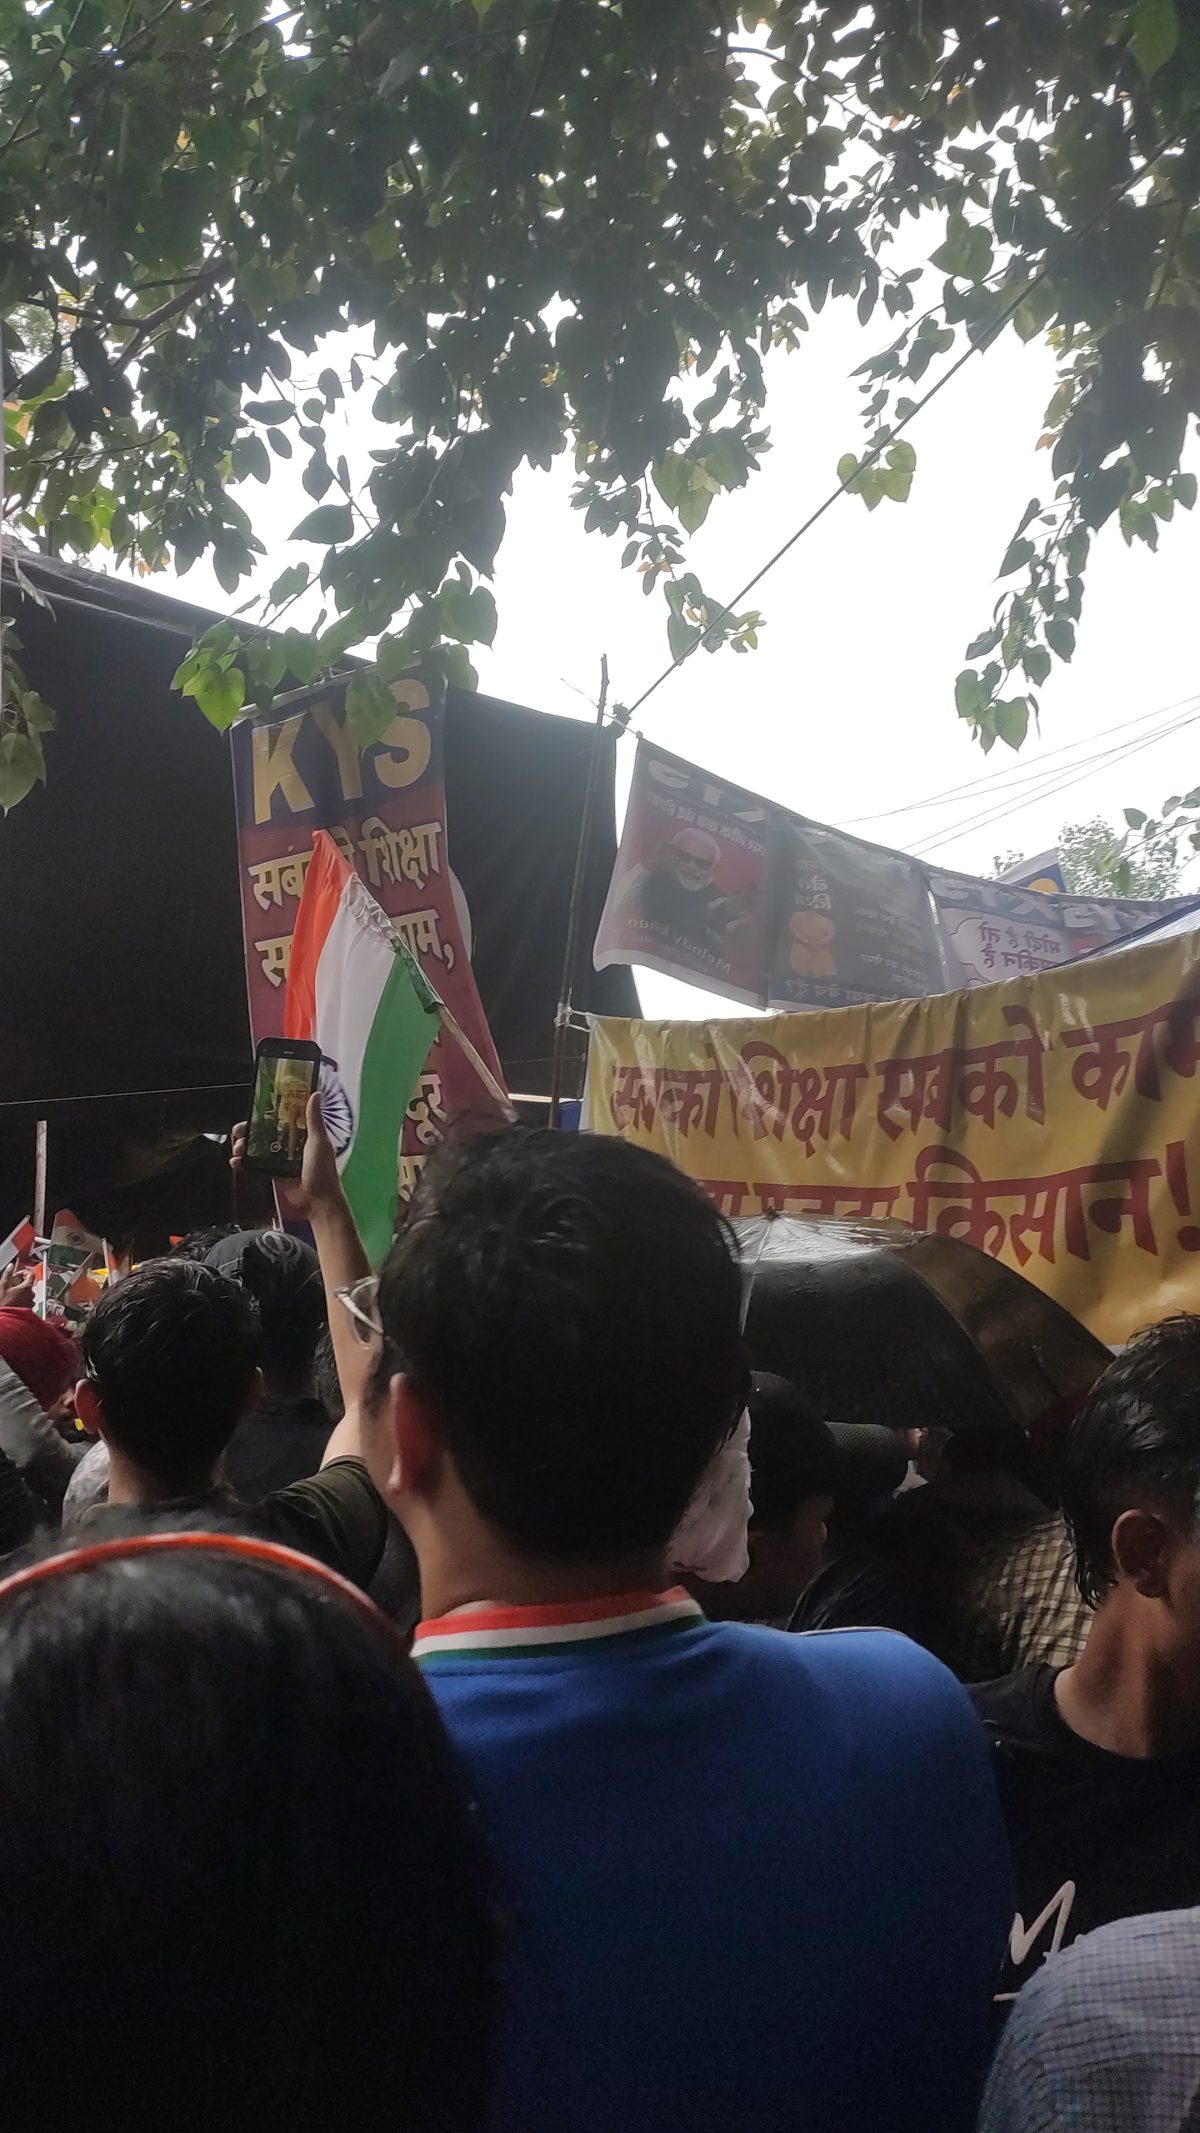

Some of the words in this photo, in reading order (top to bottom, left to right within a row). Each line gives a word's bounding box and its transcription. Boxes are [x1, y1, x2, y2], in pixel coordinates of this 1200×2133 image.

[252, 679, 432, 825] KYS
[357, 817, 442, 891] शिक्षा
[389, 909, 455, 970] ाम,
[729, 1040, 868, 1158] शिक्षा
[874, 1004, 1047, 1141] सबको
